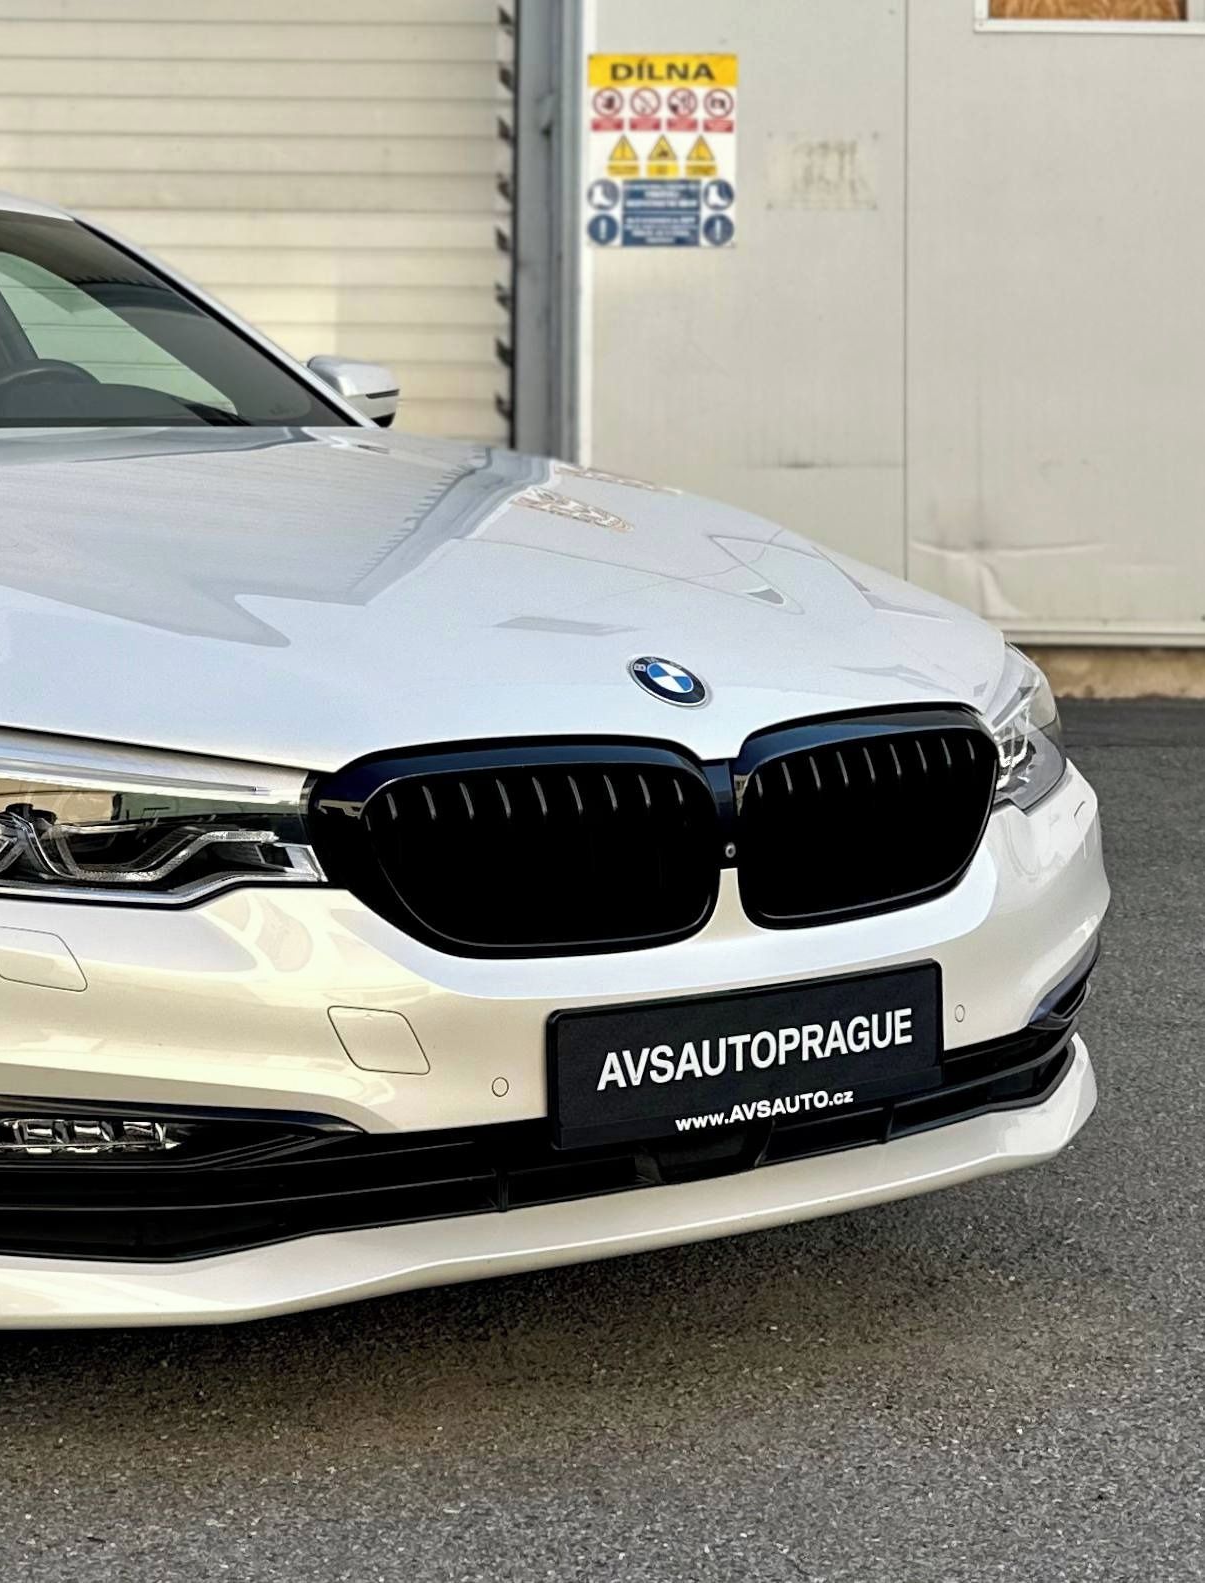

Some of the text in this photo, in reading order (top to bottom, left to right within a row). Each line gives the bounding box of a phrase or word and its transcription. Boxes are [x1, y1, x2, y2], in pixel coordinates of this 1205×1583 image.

[610, 58, 715, 81] DÍLNA
[597, 1008, 912, 1090] AVSAUTOPRAGUE
[675, 1091, 853, 1131] www.AVSAUTO.cz
